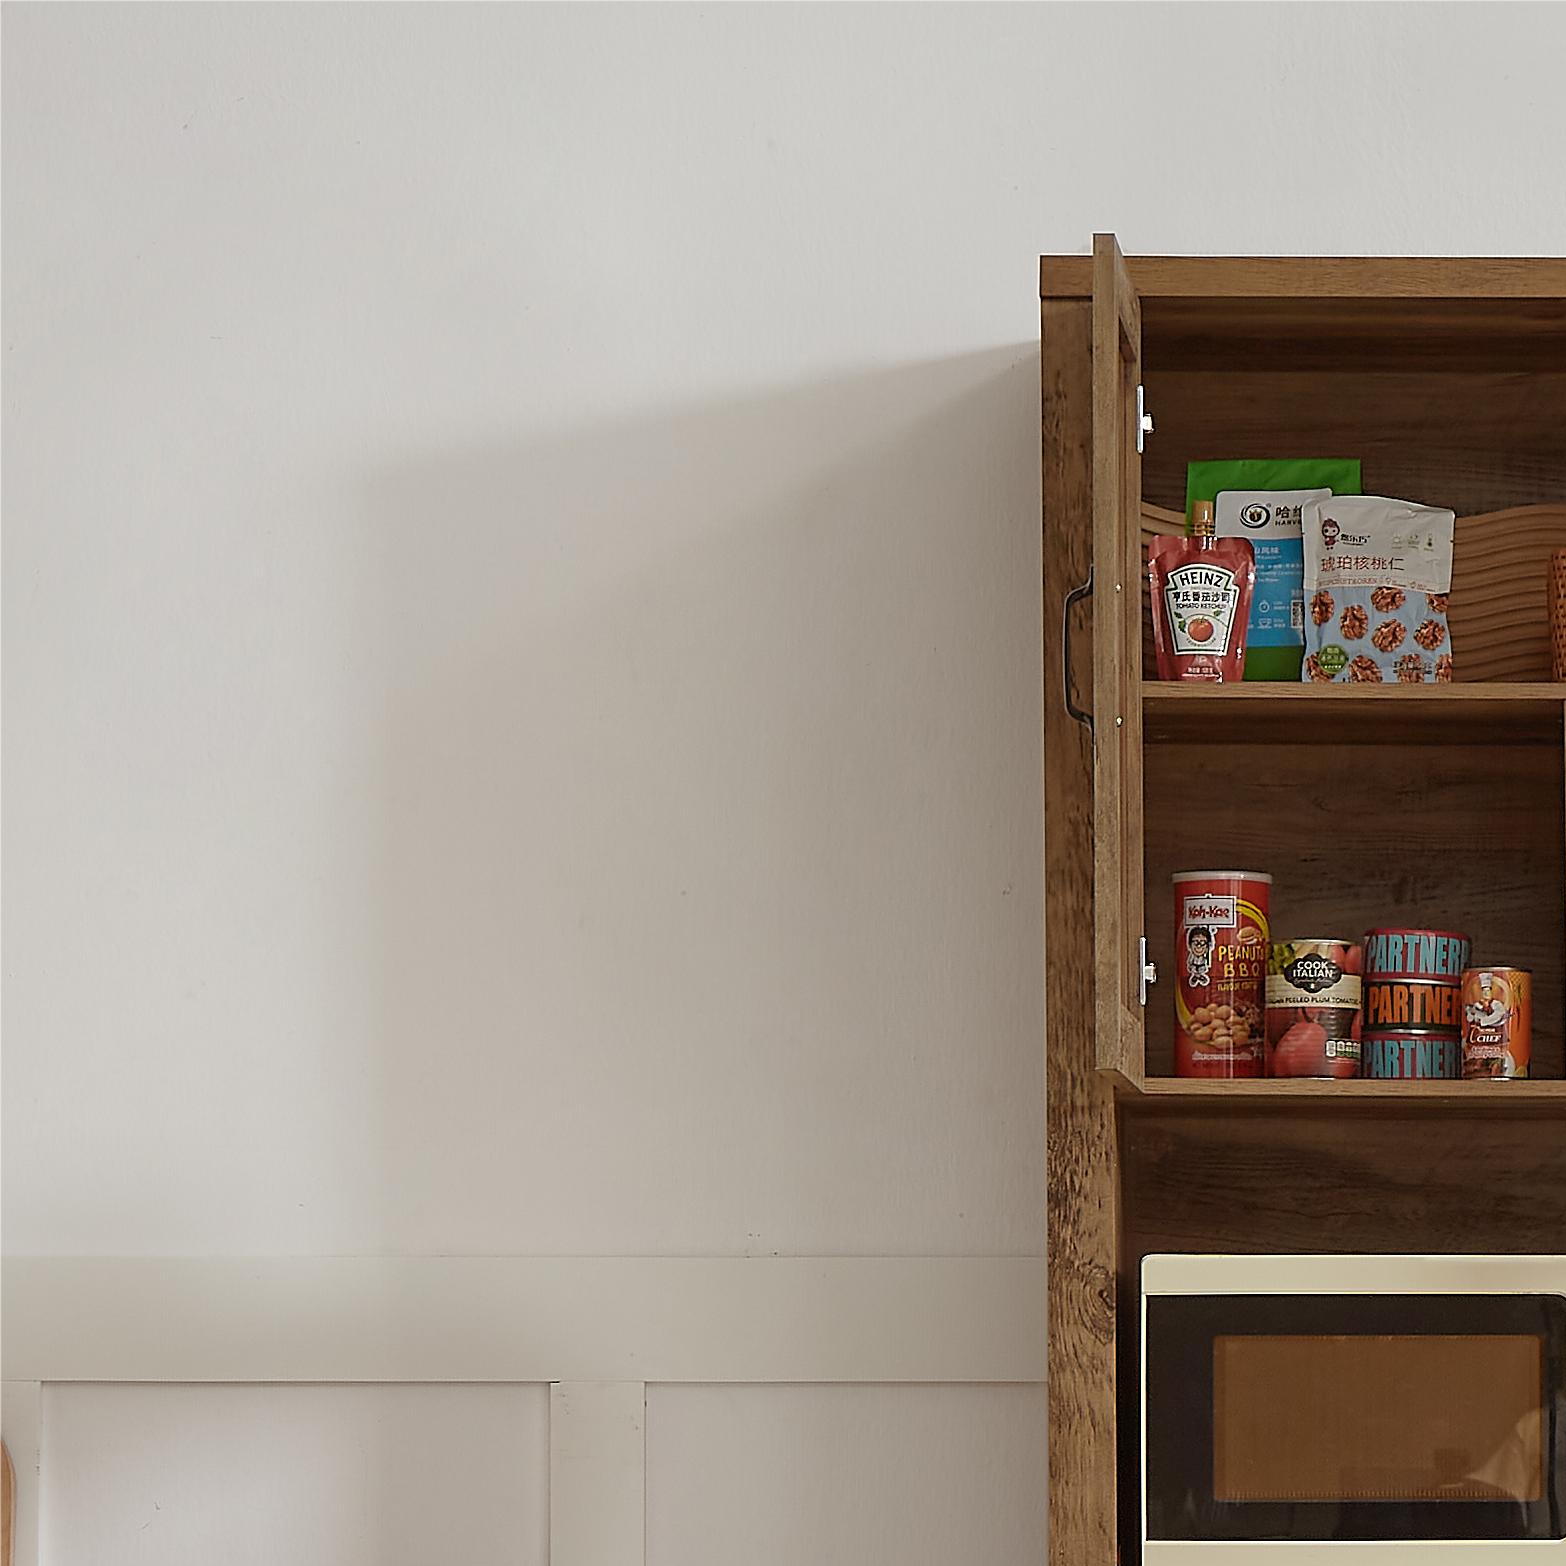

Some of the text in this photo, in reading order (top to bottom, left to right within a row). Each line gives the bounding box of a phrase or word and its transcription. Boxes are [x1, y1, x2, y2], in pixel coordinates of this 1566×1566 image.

[1320, 554, 1405, 573] 琥珀核桃仁
[1179, 571, 1224, 587] HEINZ
[1367, 934, 1461, 976] PARTNER
[1293, 969, 1333, 978] ITALIAN
[1297, 961, 1329, 970] COOK
[1368, 984, 1462, 1025] PARTNER
[1363, 1040, 1462, 1079] PARTNER
